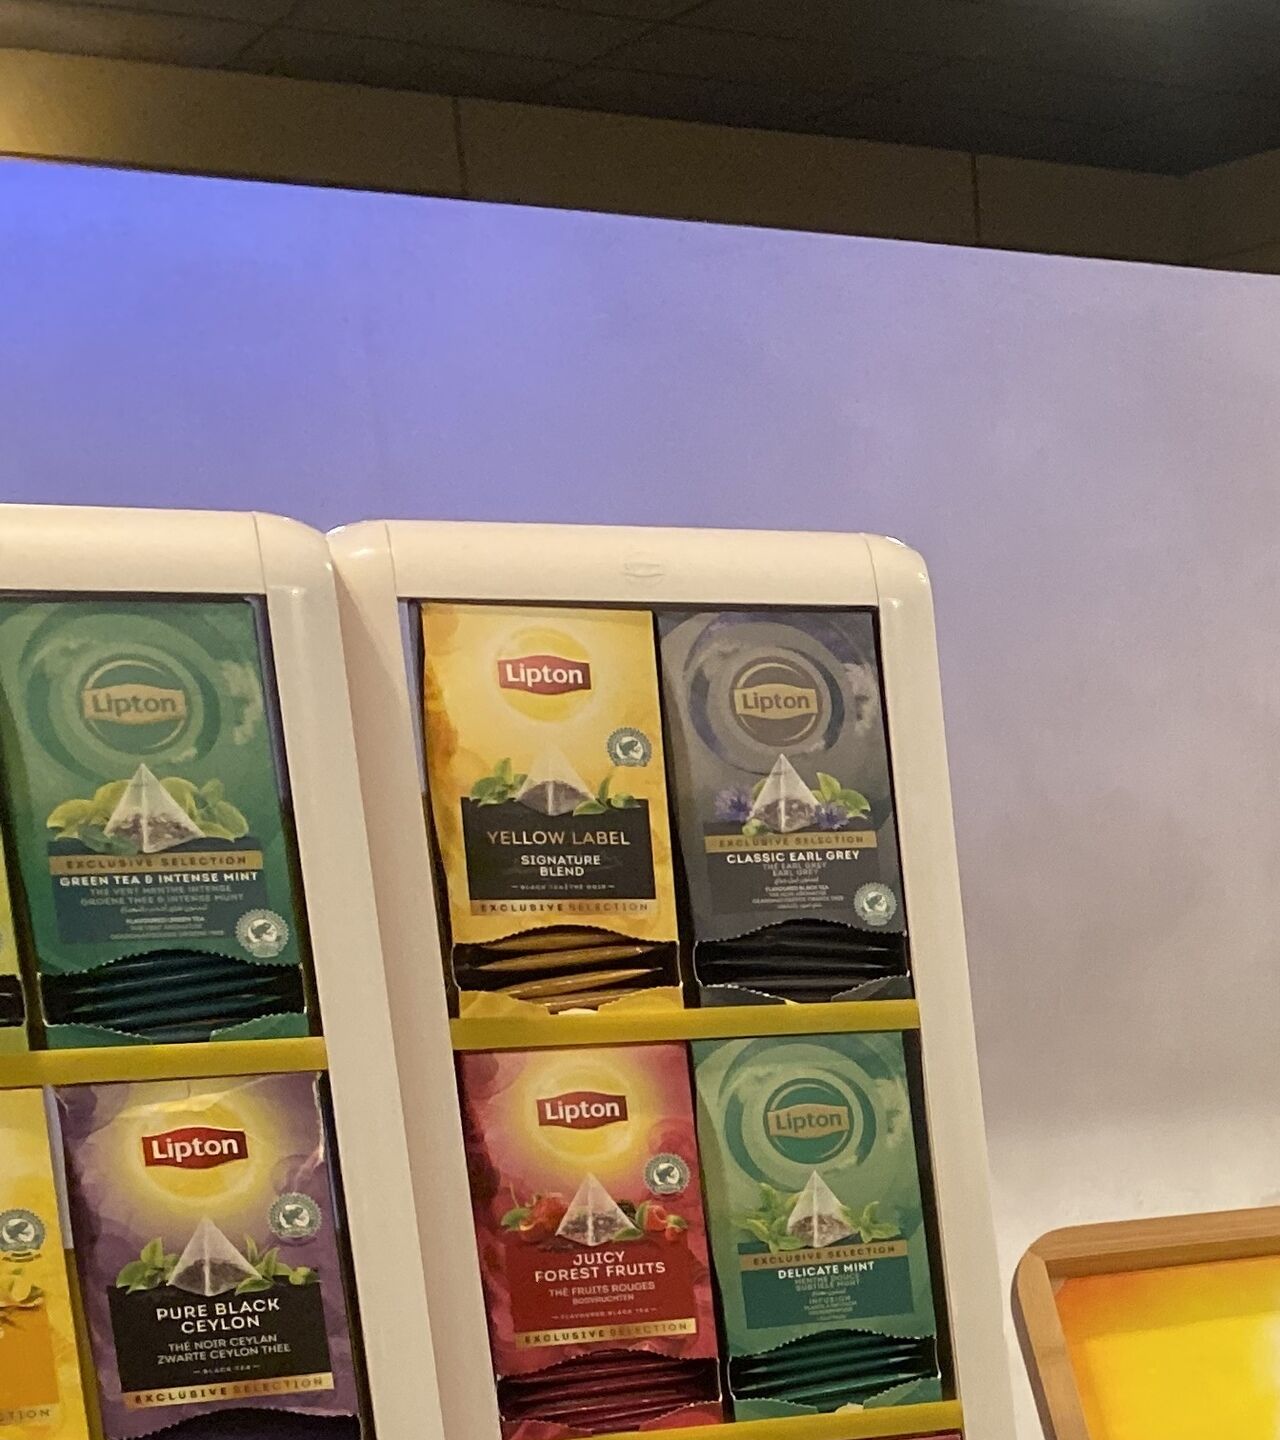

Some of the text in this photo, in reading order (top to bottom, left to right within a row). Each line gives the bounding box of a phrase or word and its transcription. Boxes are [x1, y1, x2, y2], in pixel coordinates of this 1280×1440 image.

[506, 663, 583, 688] Lipton
[91, 692, 177, 717] Lipton
[742, 692, 810, 714] Lipton
[487, 830, 631, 845] YELLOW LABEL
[719, 836, 864, 848] EXCLUSIVE SELECTION
[66, 856, 247, 870] EXCLUSIVE SELECTION
[520, 854, 602, 866] SIGNATURE
[726, 850, 860, 864] CLASSIC EARL GREY
[59, 875, 109, 887] GREEN
[113, 875, 141, 885] TEA
[158, 873, 219, 884] INTENSE
[223, 871, 258, 882] MINT
[539, 866, 585, 877] BLEND
[481, 903, 648, 912] EXCLUSIVE SELECTION
[545, 1101, 620, 1123] Lipton
[776, 1111, 842, 1132] Lipton
[152, 1136, 239, 1162] Lipton
[573, 1251, 625, 1266] JUICY
[753, 1246, 896, 1266] EXCLUSIVE SELECTION
[535, 1262, 666, 1283] FOREST FRUITS
[778, 1261, 874, 1279] DELICATE MINT
[571, 1284, 609, 1296] FRUITS
[611, 1281, 655, 1293] ROUGES
[156, 1298, 280, 1321] PURE BLACK
[181, 1315, 261, 1334] CEYLON
[525, 1322, 688, 1343] EXCLUSIVE SELECTION
[194, 1338, 226, 1351] NOIR
[229, 1334, 278, 1348] CEYLAN
[157, 1343, 292, 1365] ZWARTE CEYLON THEE
[135, 1378, 324, 1404] EXCLUSIVE SELECTION
